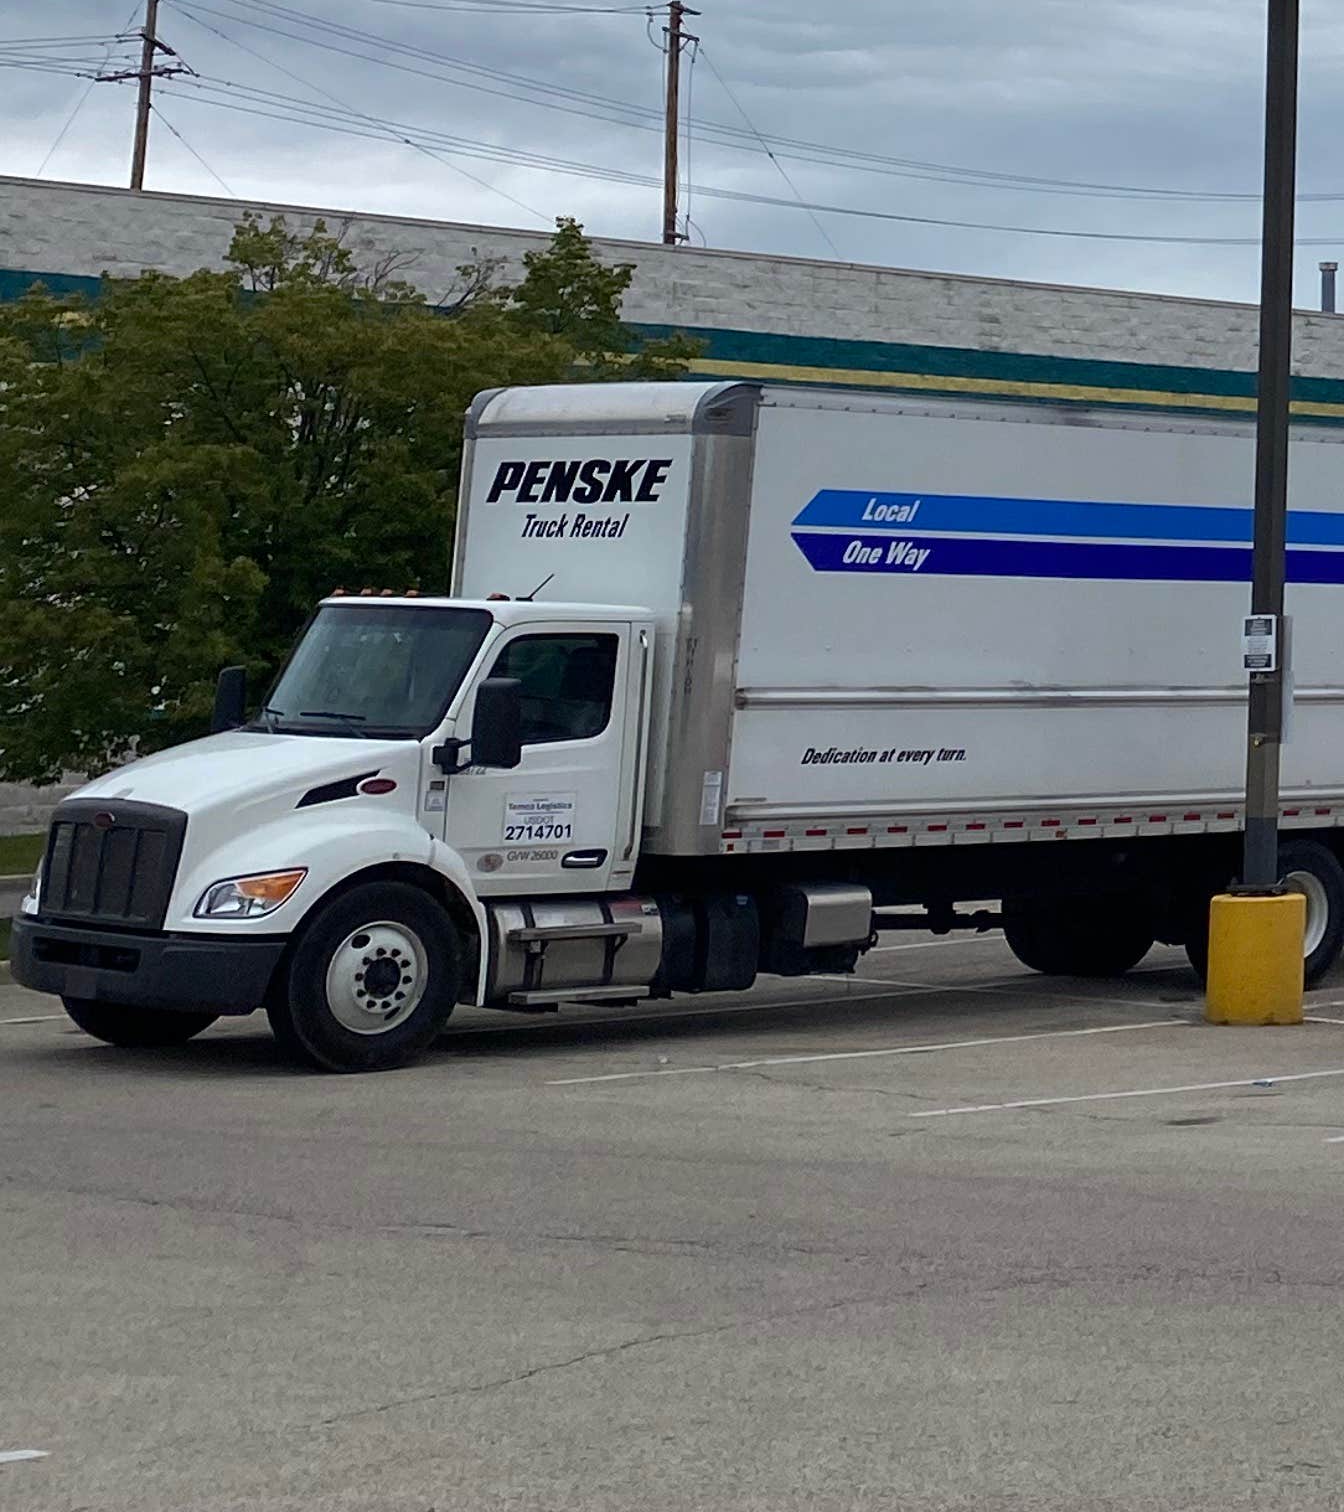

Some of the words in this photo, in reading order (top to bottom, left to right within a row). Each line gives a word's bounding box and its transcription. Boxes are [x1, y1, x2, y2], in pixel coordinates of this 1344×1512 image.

[486, 459, 673, 504] PENSKE
[861, 498, 920, 522] Local
[521, 514, 568, 538] Truck
[570, 513, 630, 538] Rental
[842, 540, 883, 564] One
[885, 541, 931, 571] Way
[801, 747, 877, 764] Dedication
[879, 748, 896, 763] at
[897, 749, 935, 766] every
[936, 748, 967, 761] turn.
[537, 801, 572, 811] Logistics
[505, 825, 572, 840] 2714701
